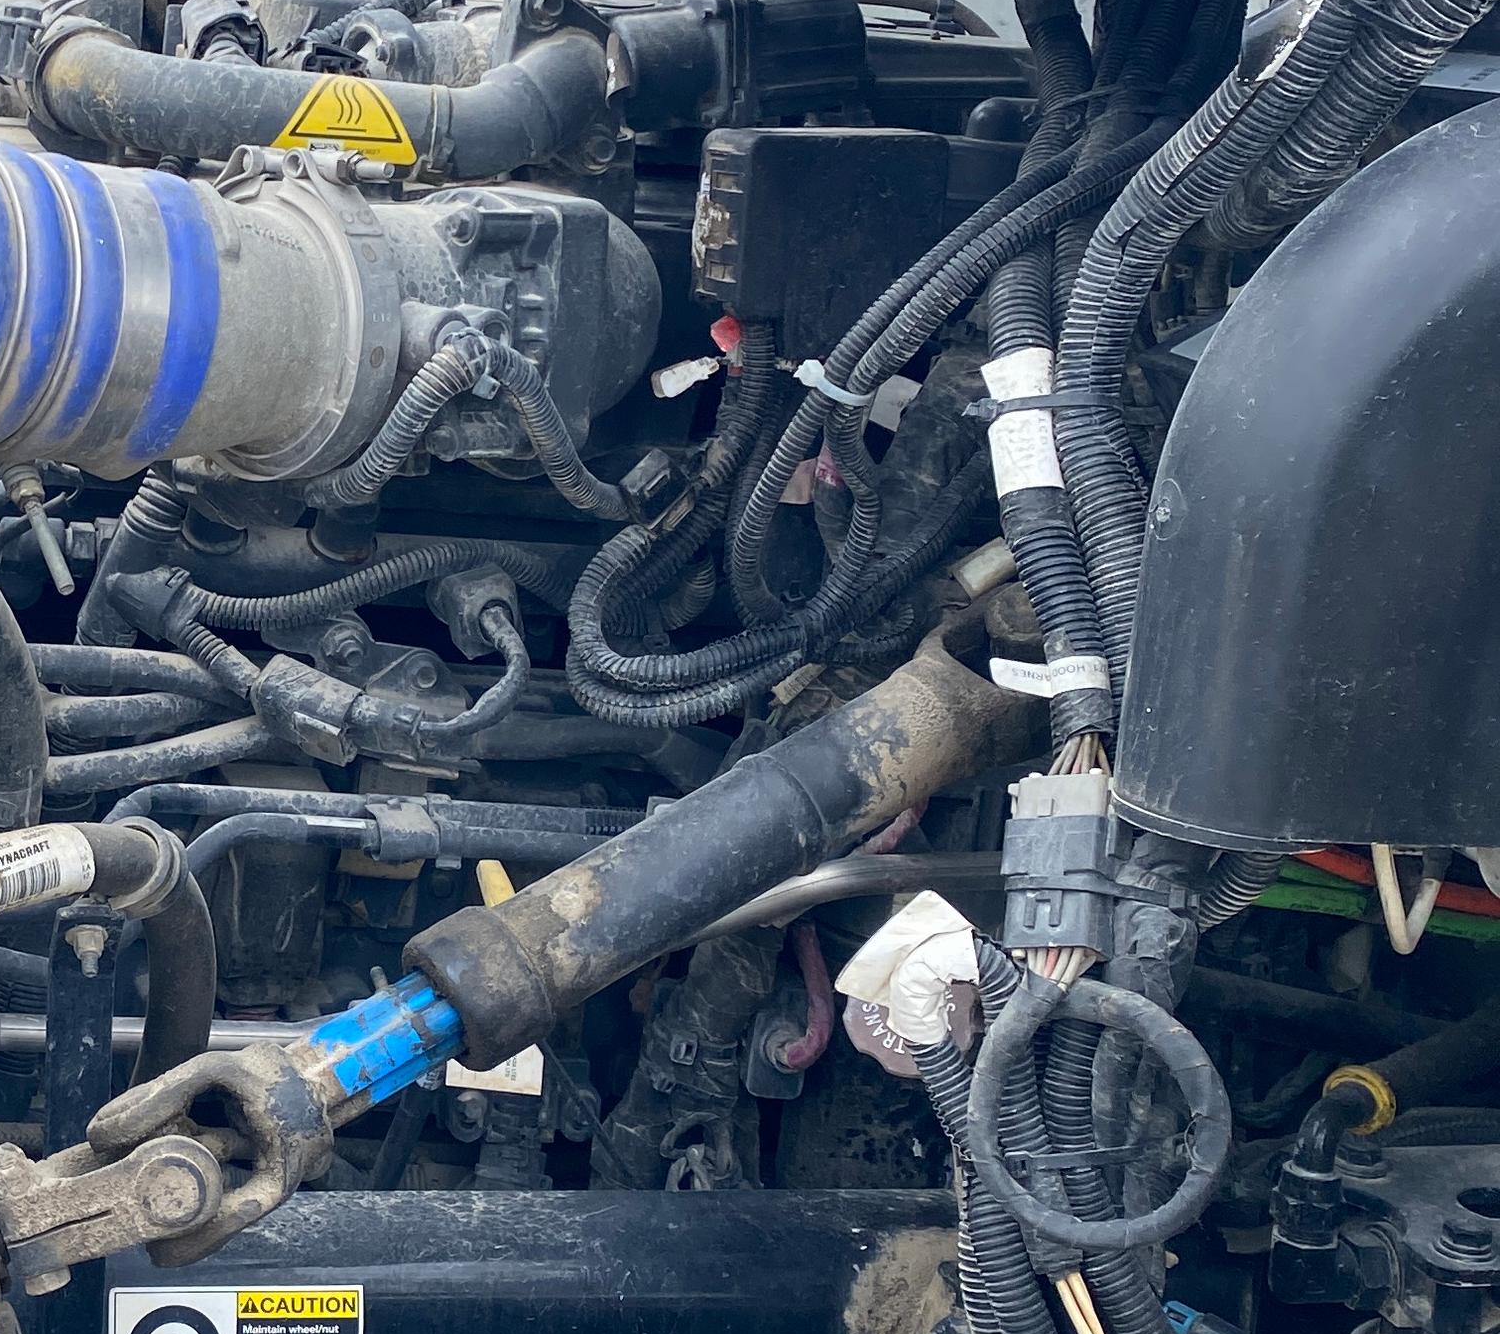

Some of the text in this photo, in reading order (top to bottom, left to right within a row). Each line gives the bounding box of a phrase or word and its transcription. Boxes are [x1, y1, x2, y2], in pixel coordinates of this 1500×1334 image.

[260, 1296, 356, 1313] CAUTION
[242, 1324, 340, 1334] Maintain wheel/nut
